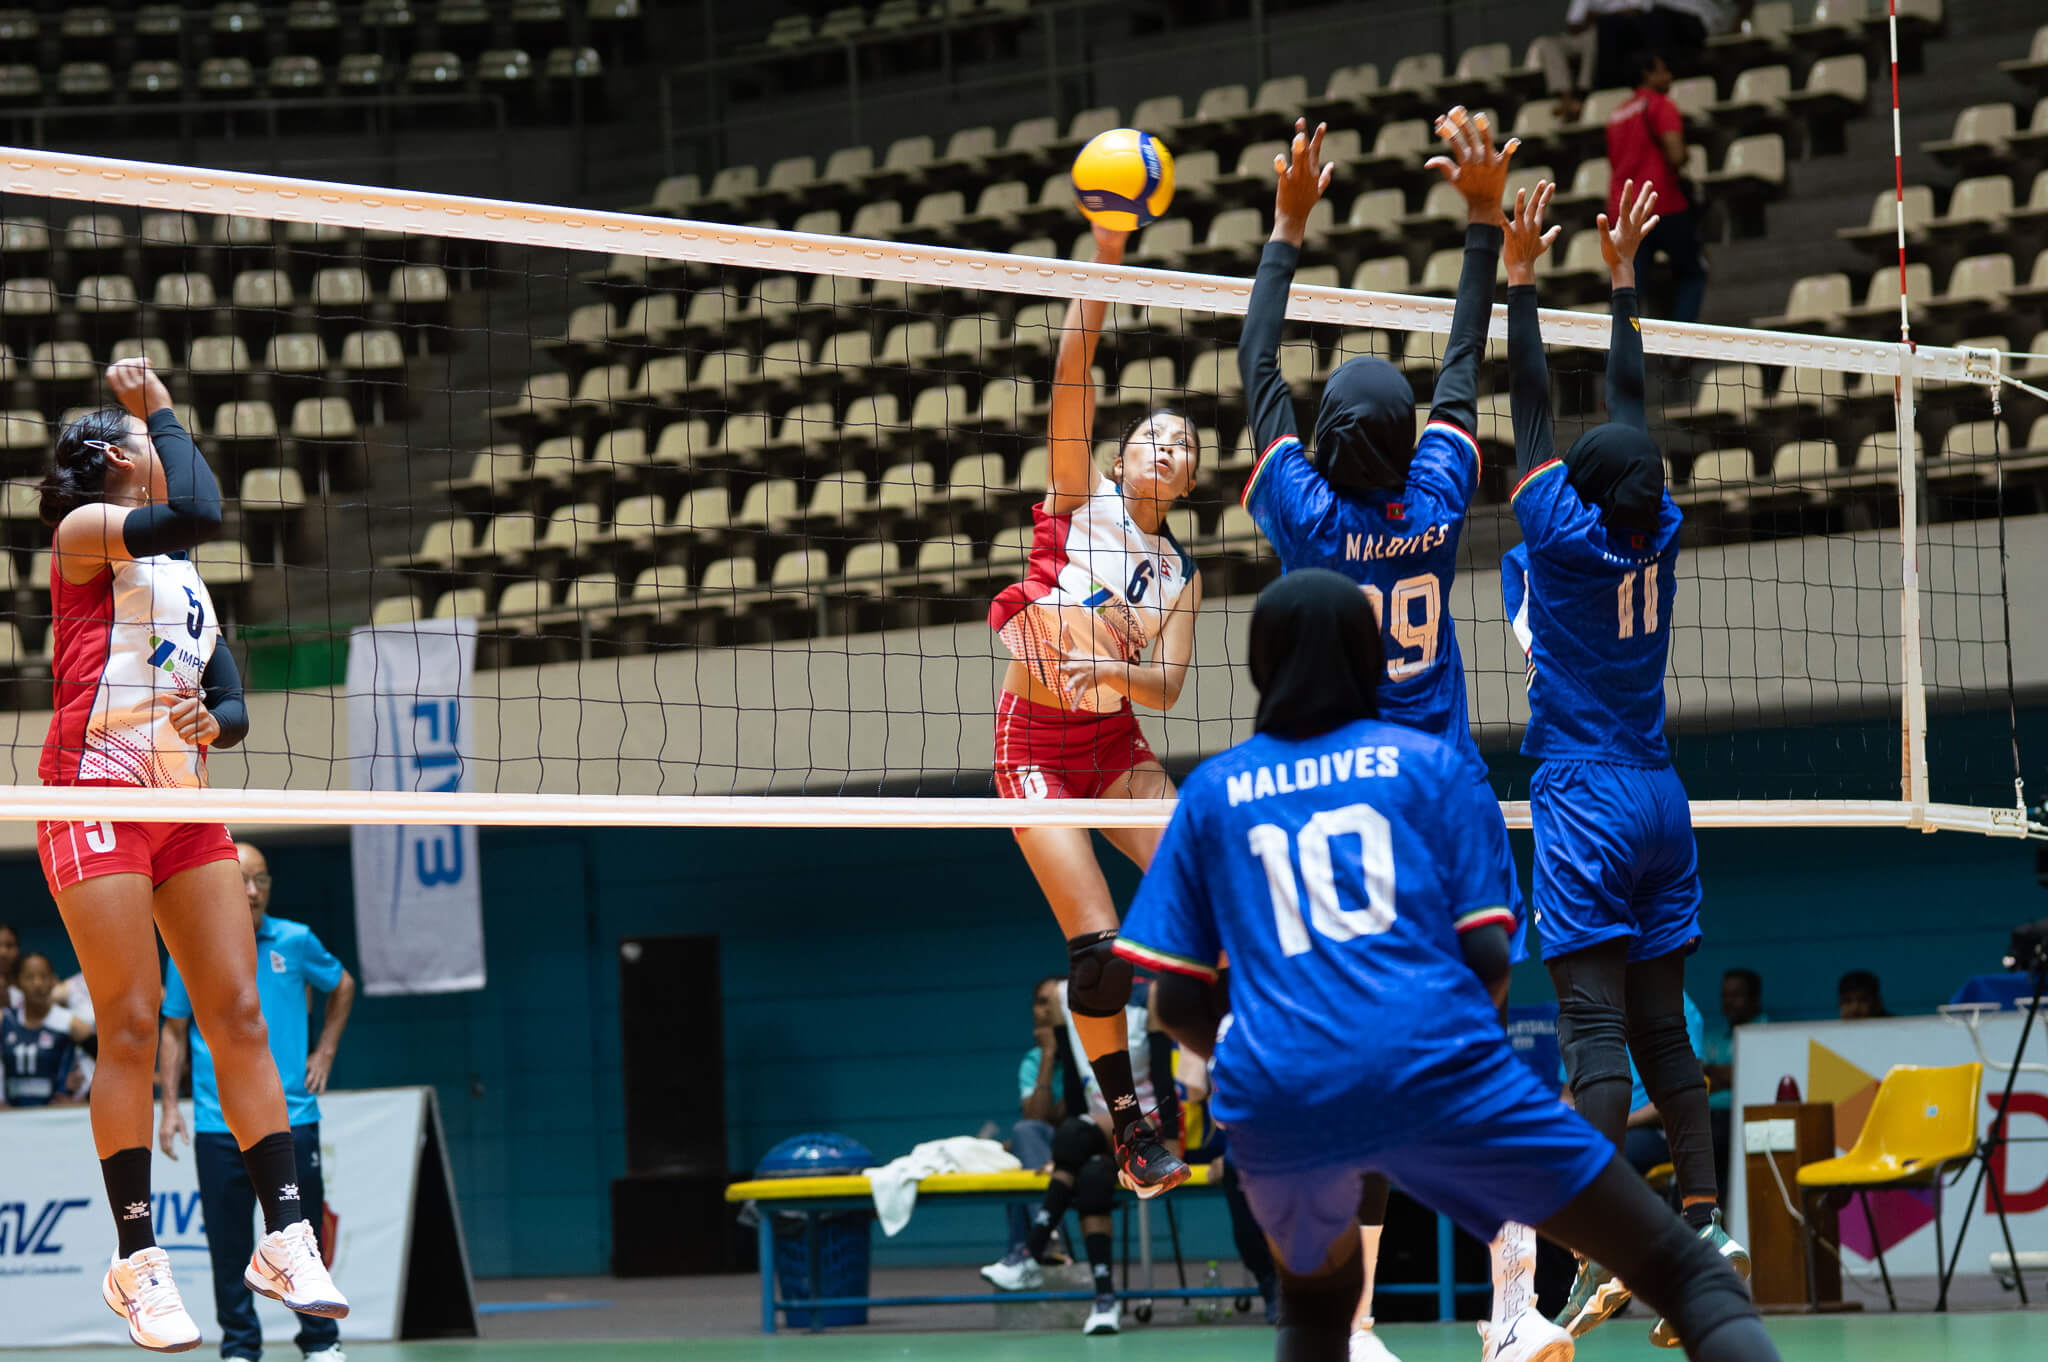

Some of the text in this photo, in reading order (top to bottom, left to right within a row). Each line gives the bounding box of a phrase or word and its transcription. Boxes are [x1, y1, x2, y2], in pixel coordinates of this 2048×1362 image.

[1345, 523, 1449, 562] MALDIVES
[1126, 559, 1154, 604] 6
[1617, 562, 1659, 640] 11
[182, 585, 205, 640] 5
[1226, 746, 1399, 807] MALDIVES
[1247, 803, 1397, 958] 10
